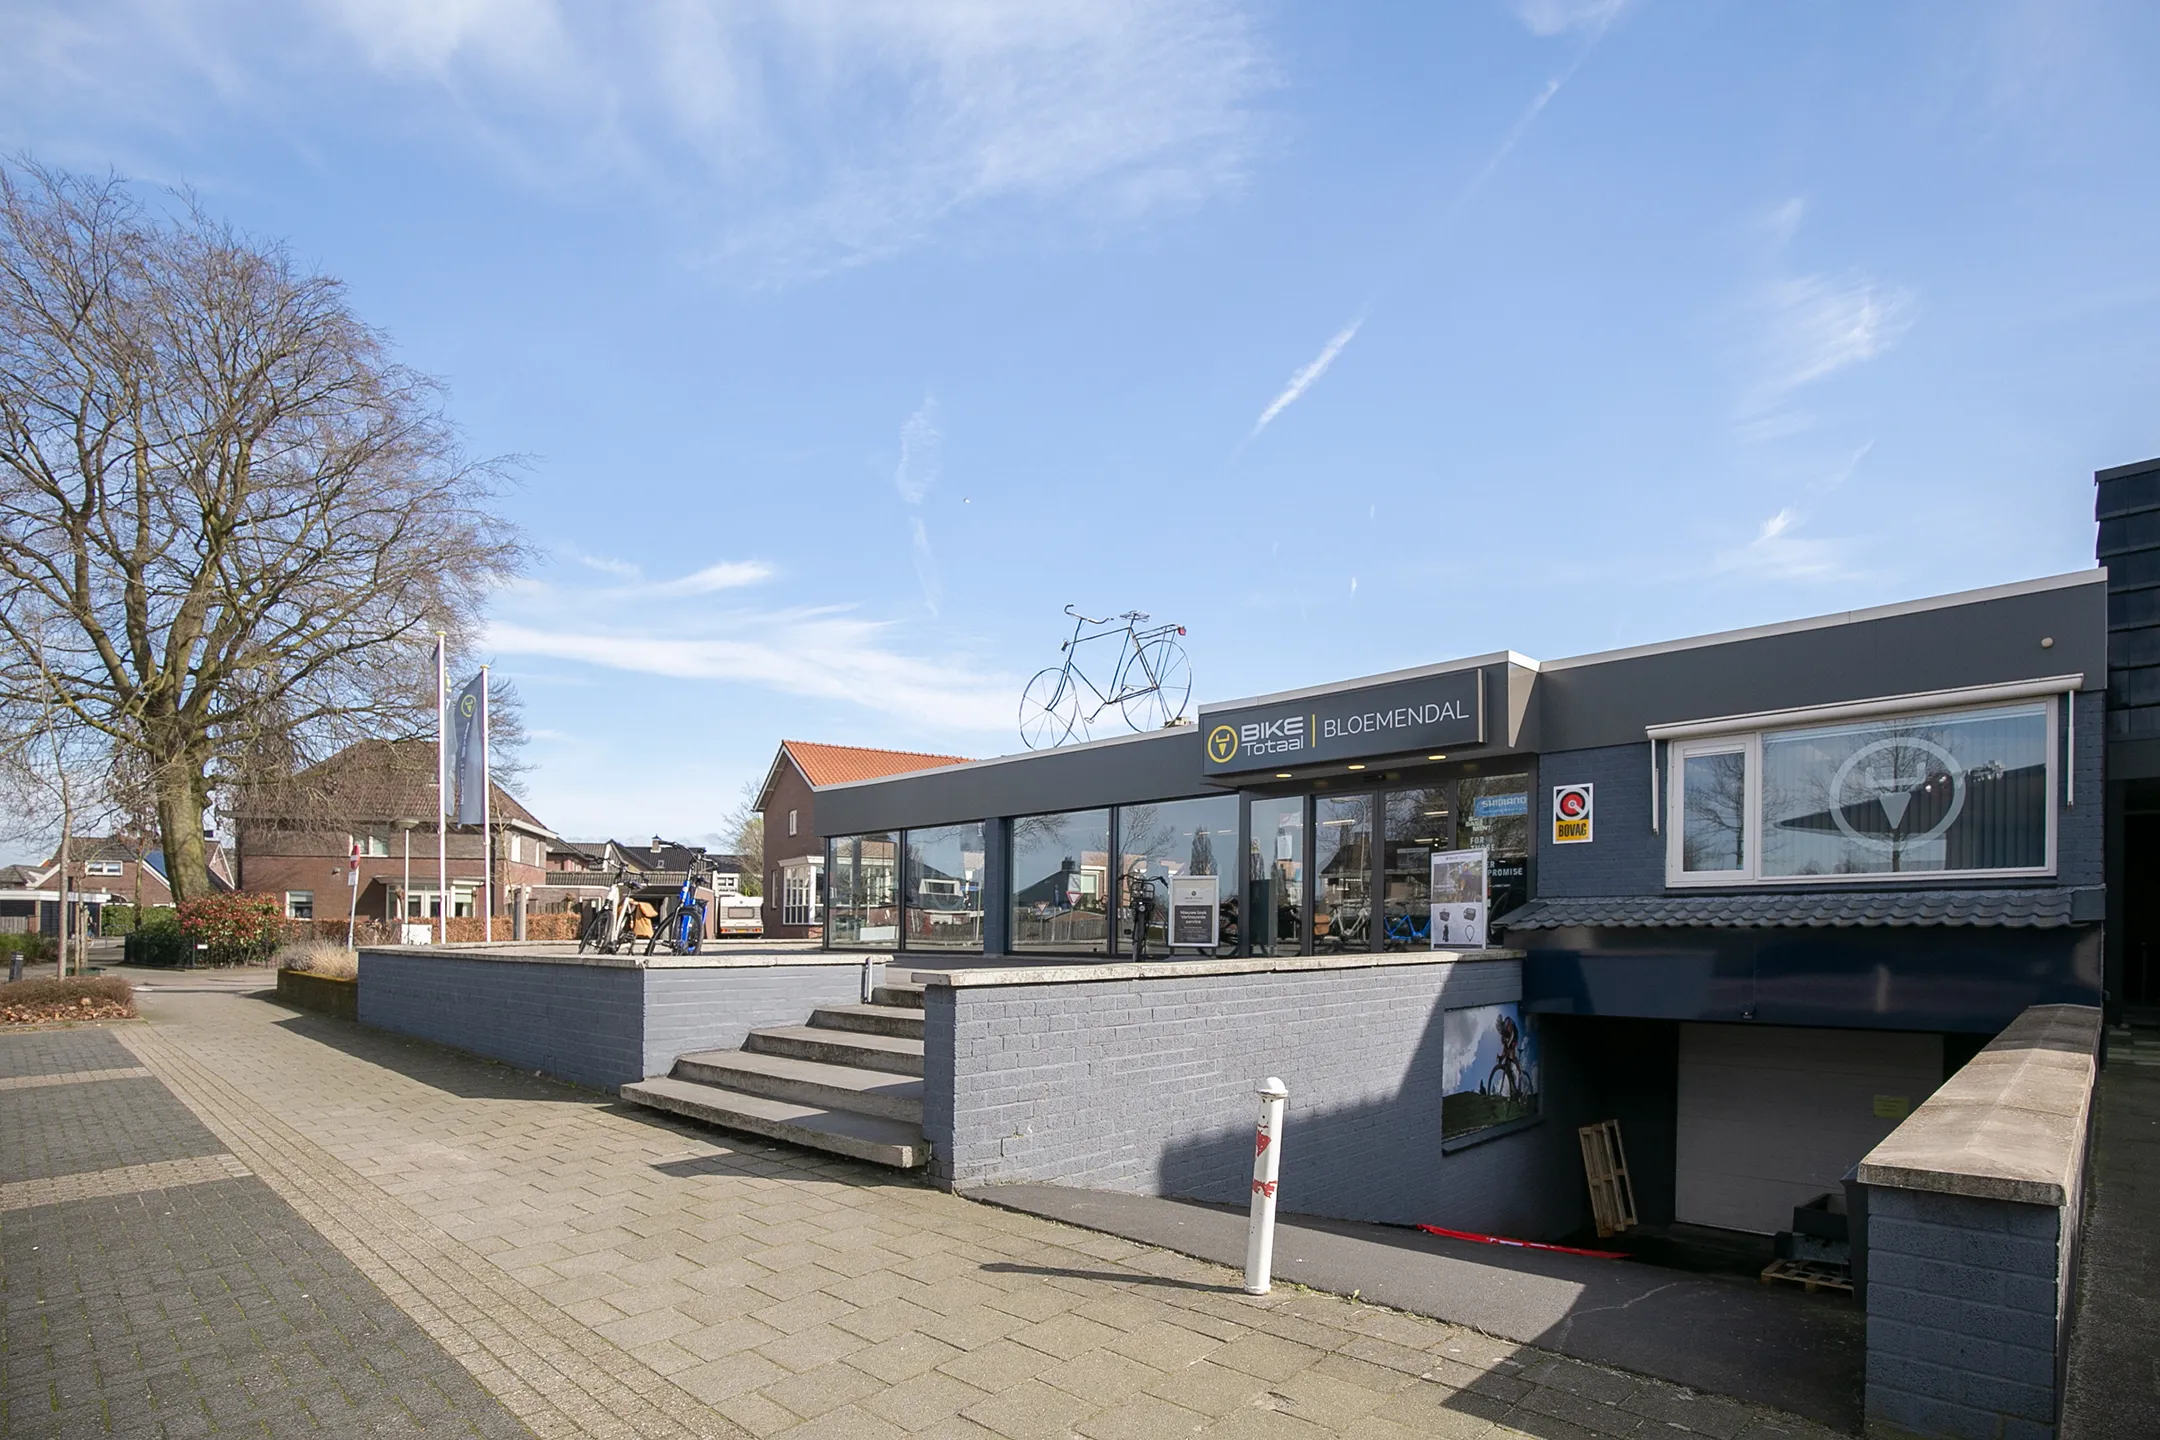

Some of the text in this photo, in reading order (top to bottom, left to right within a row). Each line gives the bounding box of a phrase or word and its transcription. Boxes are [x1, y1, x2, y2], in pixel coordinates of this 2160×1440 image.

[1241, 700, 1470, 742] BIKE BLOEMENDAL
[1241, 735, 1304, 757] Totaal
[1482, 796, 1527, 808] SHIMANO
[1558, 823, 1587, 838] BOVAG
[1470, 836, 1485, 845] FOR
